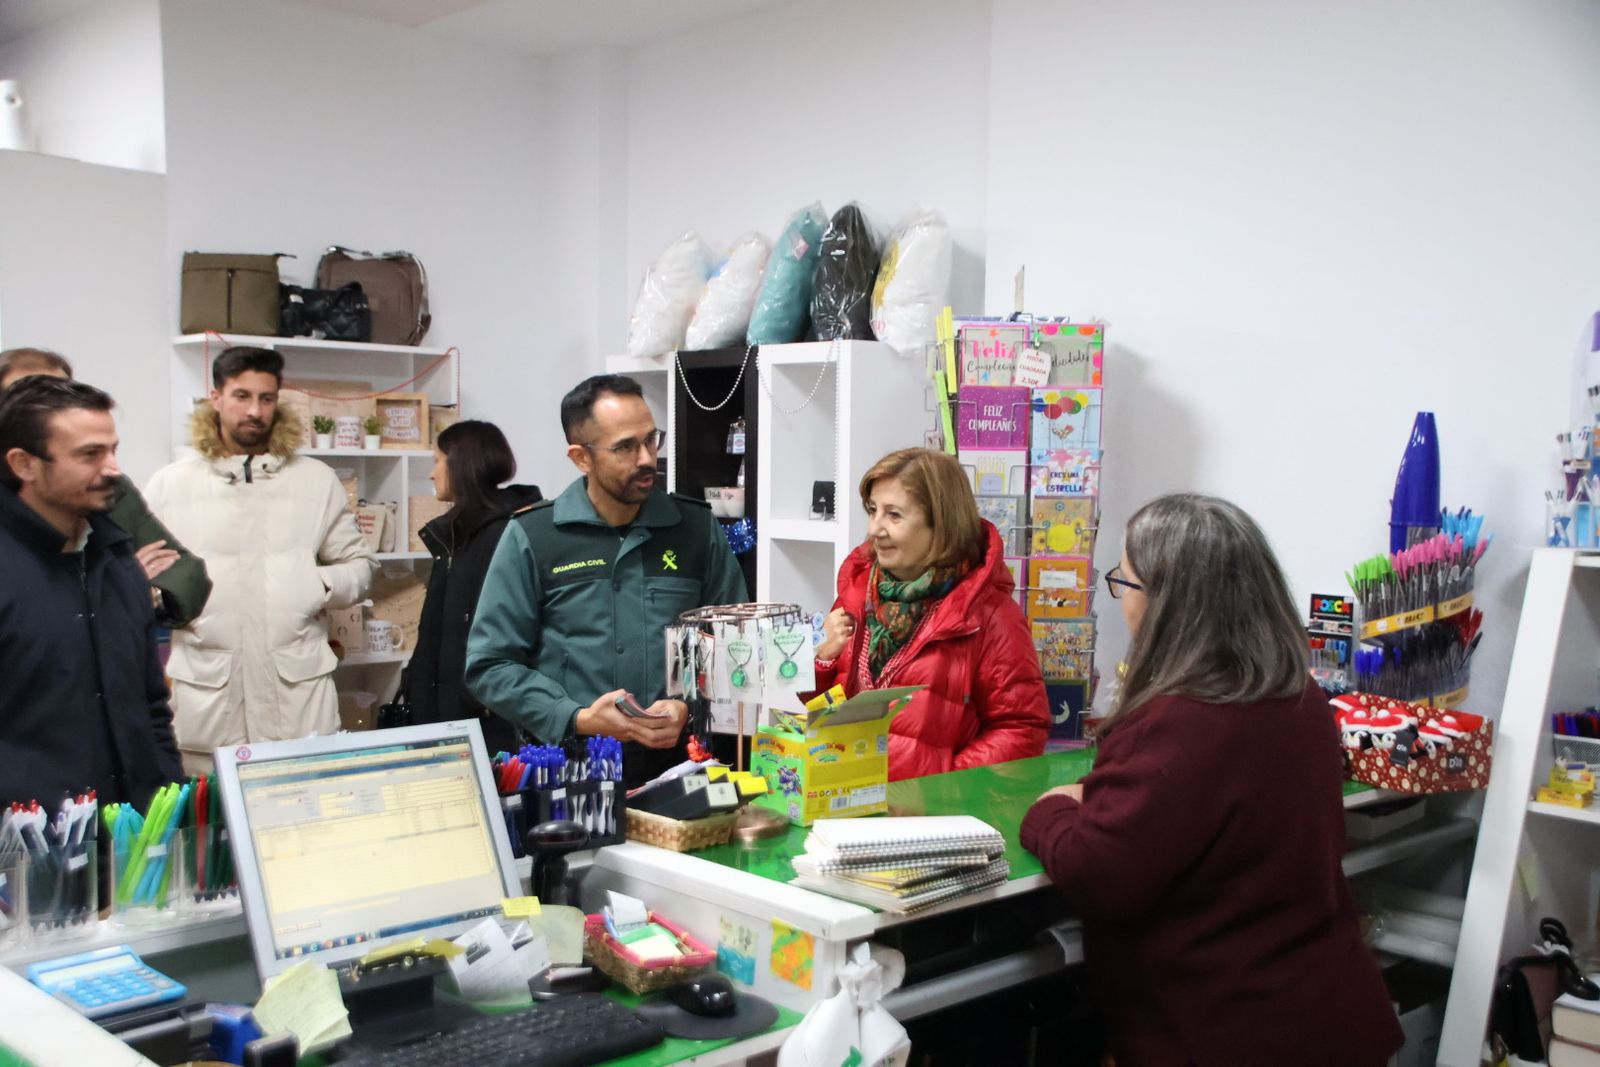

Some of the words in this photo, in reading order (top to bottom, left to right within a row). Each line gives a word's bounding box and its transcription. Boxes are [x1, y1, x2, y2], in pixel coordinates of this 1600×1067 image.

[972, 340, 1018, 359] Feliz
[983, 405, 1004, 417] FELIZ
[968, 417, 1017, 432] CUMPLEAÑOS
[1046, 484, 1086, 493] ESTRELLA
[552, 561, 587, 574] GUARDIA
[587, 558, 607, 567] CIVIL
[1313, 598, 1351, 614] POSCA
